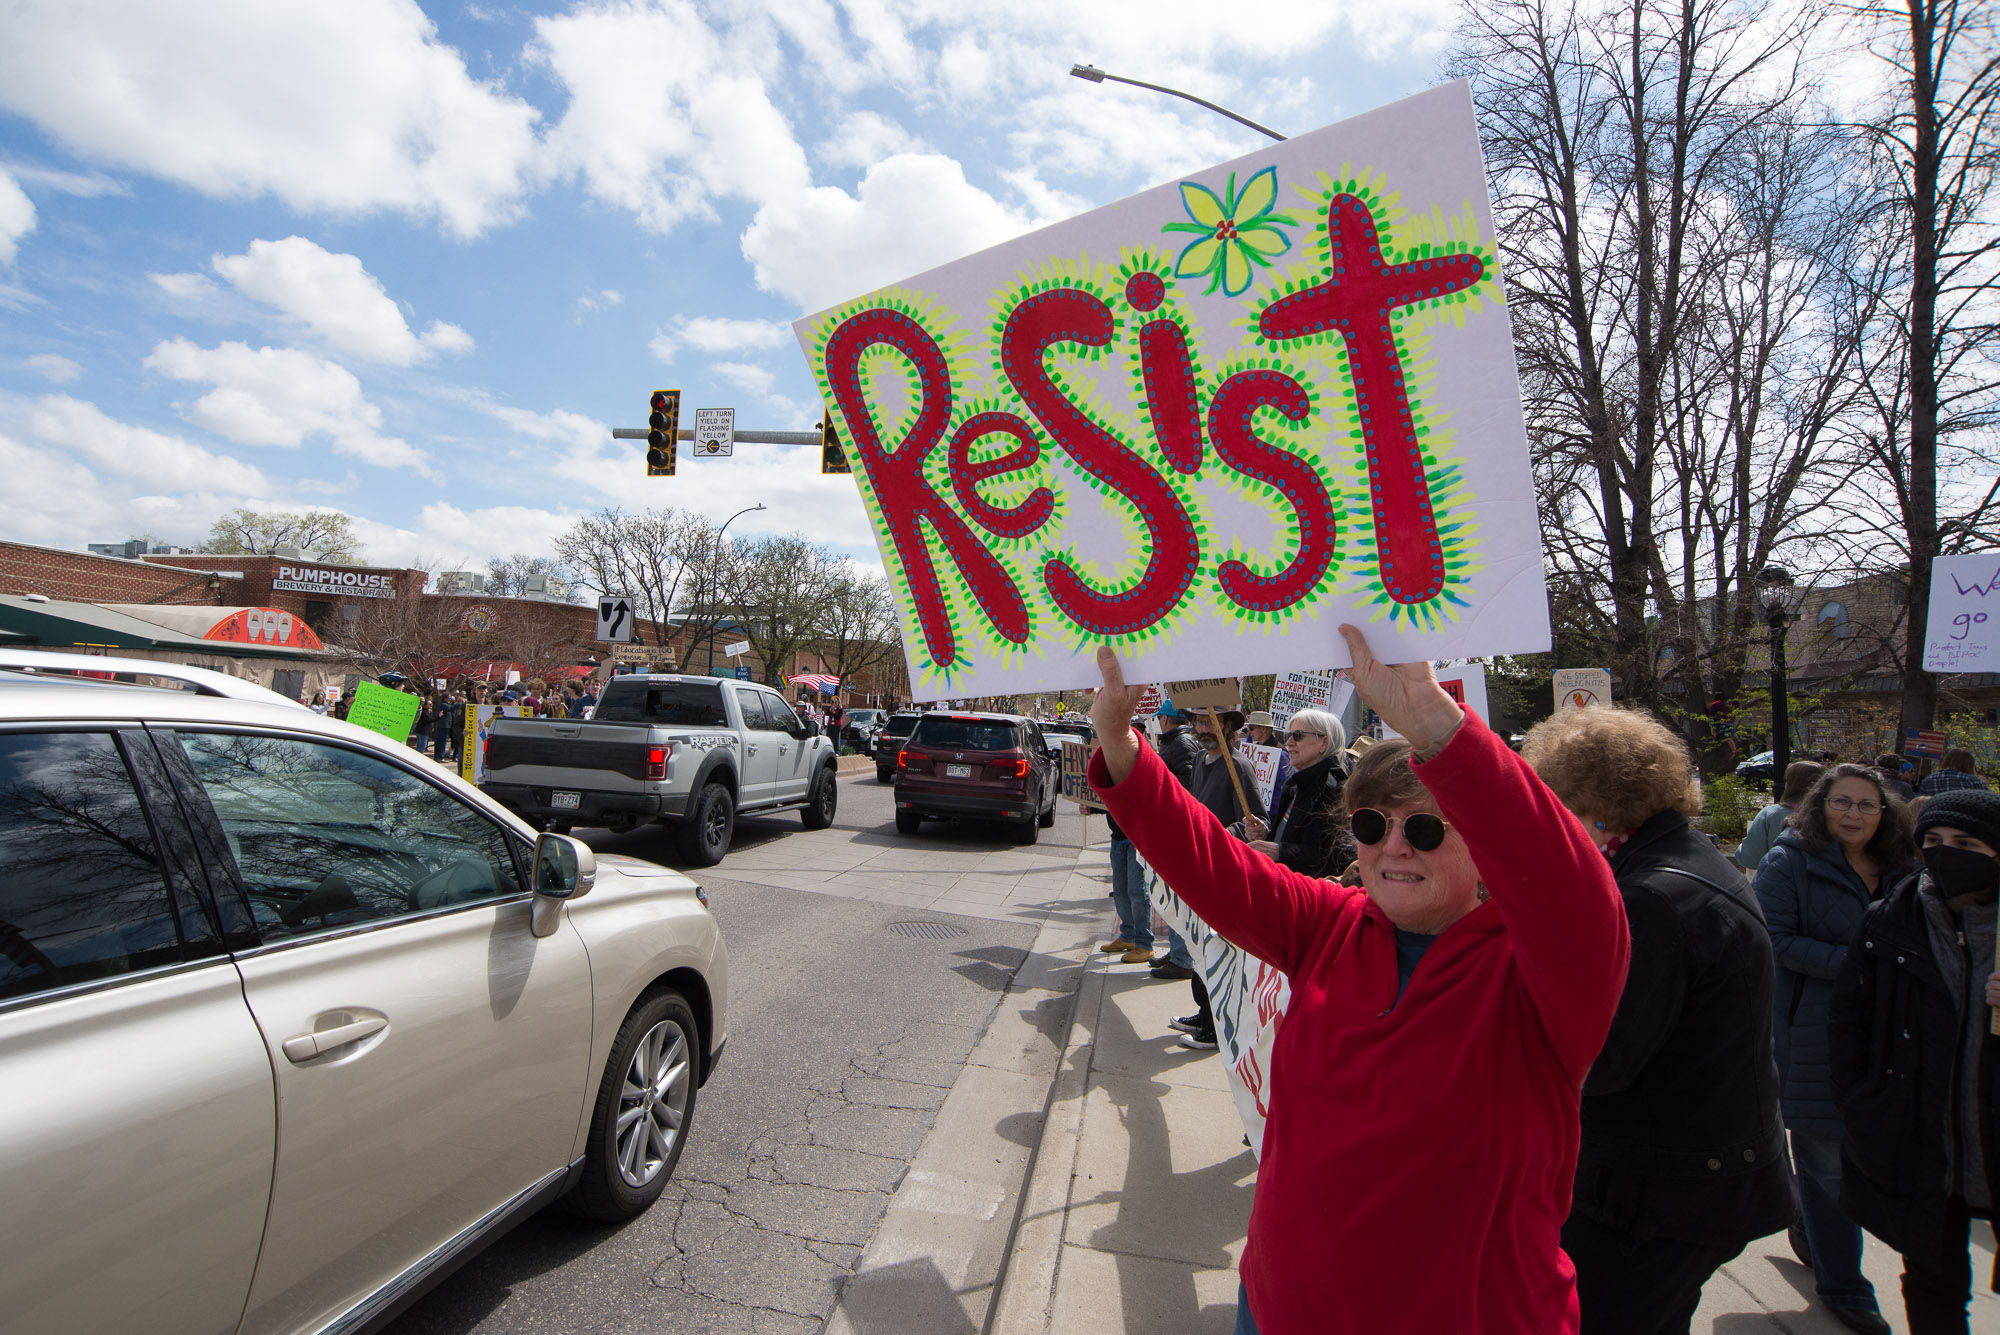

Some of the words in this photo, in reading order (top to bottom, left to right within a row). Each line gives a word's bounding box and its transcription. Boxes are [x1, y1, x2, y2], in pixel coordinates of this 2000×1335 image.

[279, 566, 393, 589] PUMPHOUSE
[276, 581, 323, 592] BREWERY
[335, 586, 395, 599] RESTAURANT
[1949, 612, 1988, 640] go
[1288, 673, 1302, 683] FOR
[1304, 676, 1317, 686] THE
[1318, 680, 1330, 688] BIG
[1560, 672, 1572, 680] WE
[1574, 671, 1602, 680] STOPPED
[1557, 680, 1585, 688] KNEELING
[1272, 694, 1309, 709] SHAKEDOWN
[689, 736, 735, 750] RAPTOR
[1241, 743, 1257, 760] TAX
[1257, 751, 1270, 763] THE
[1064, 773, 1081, 798] OFF
